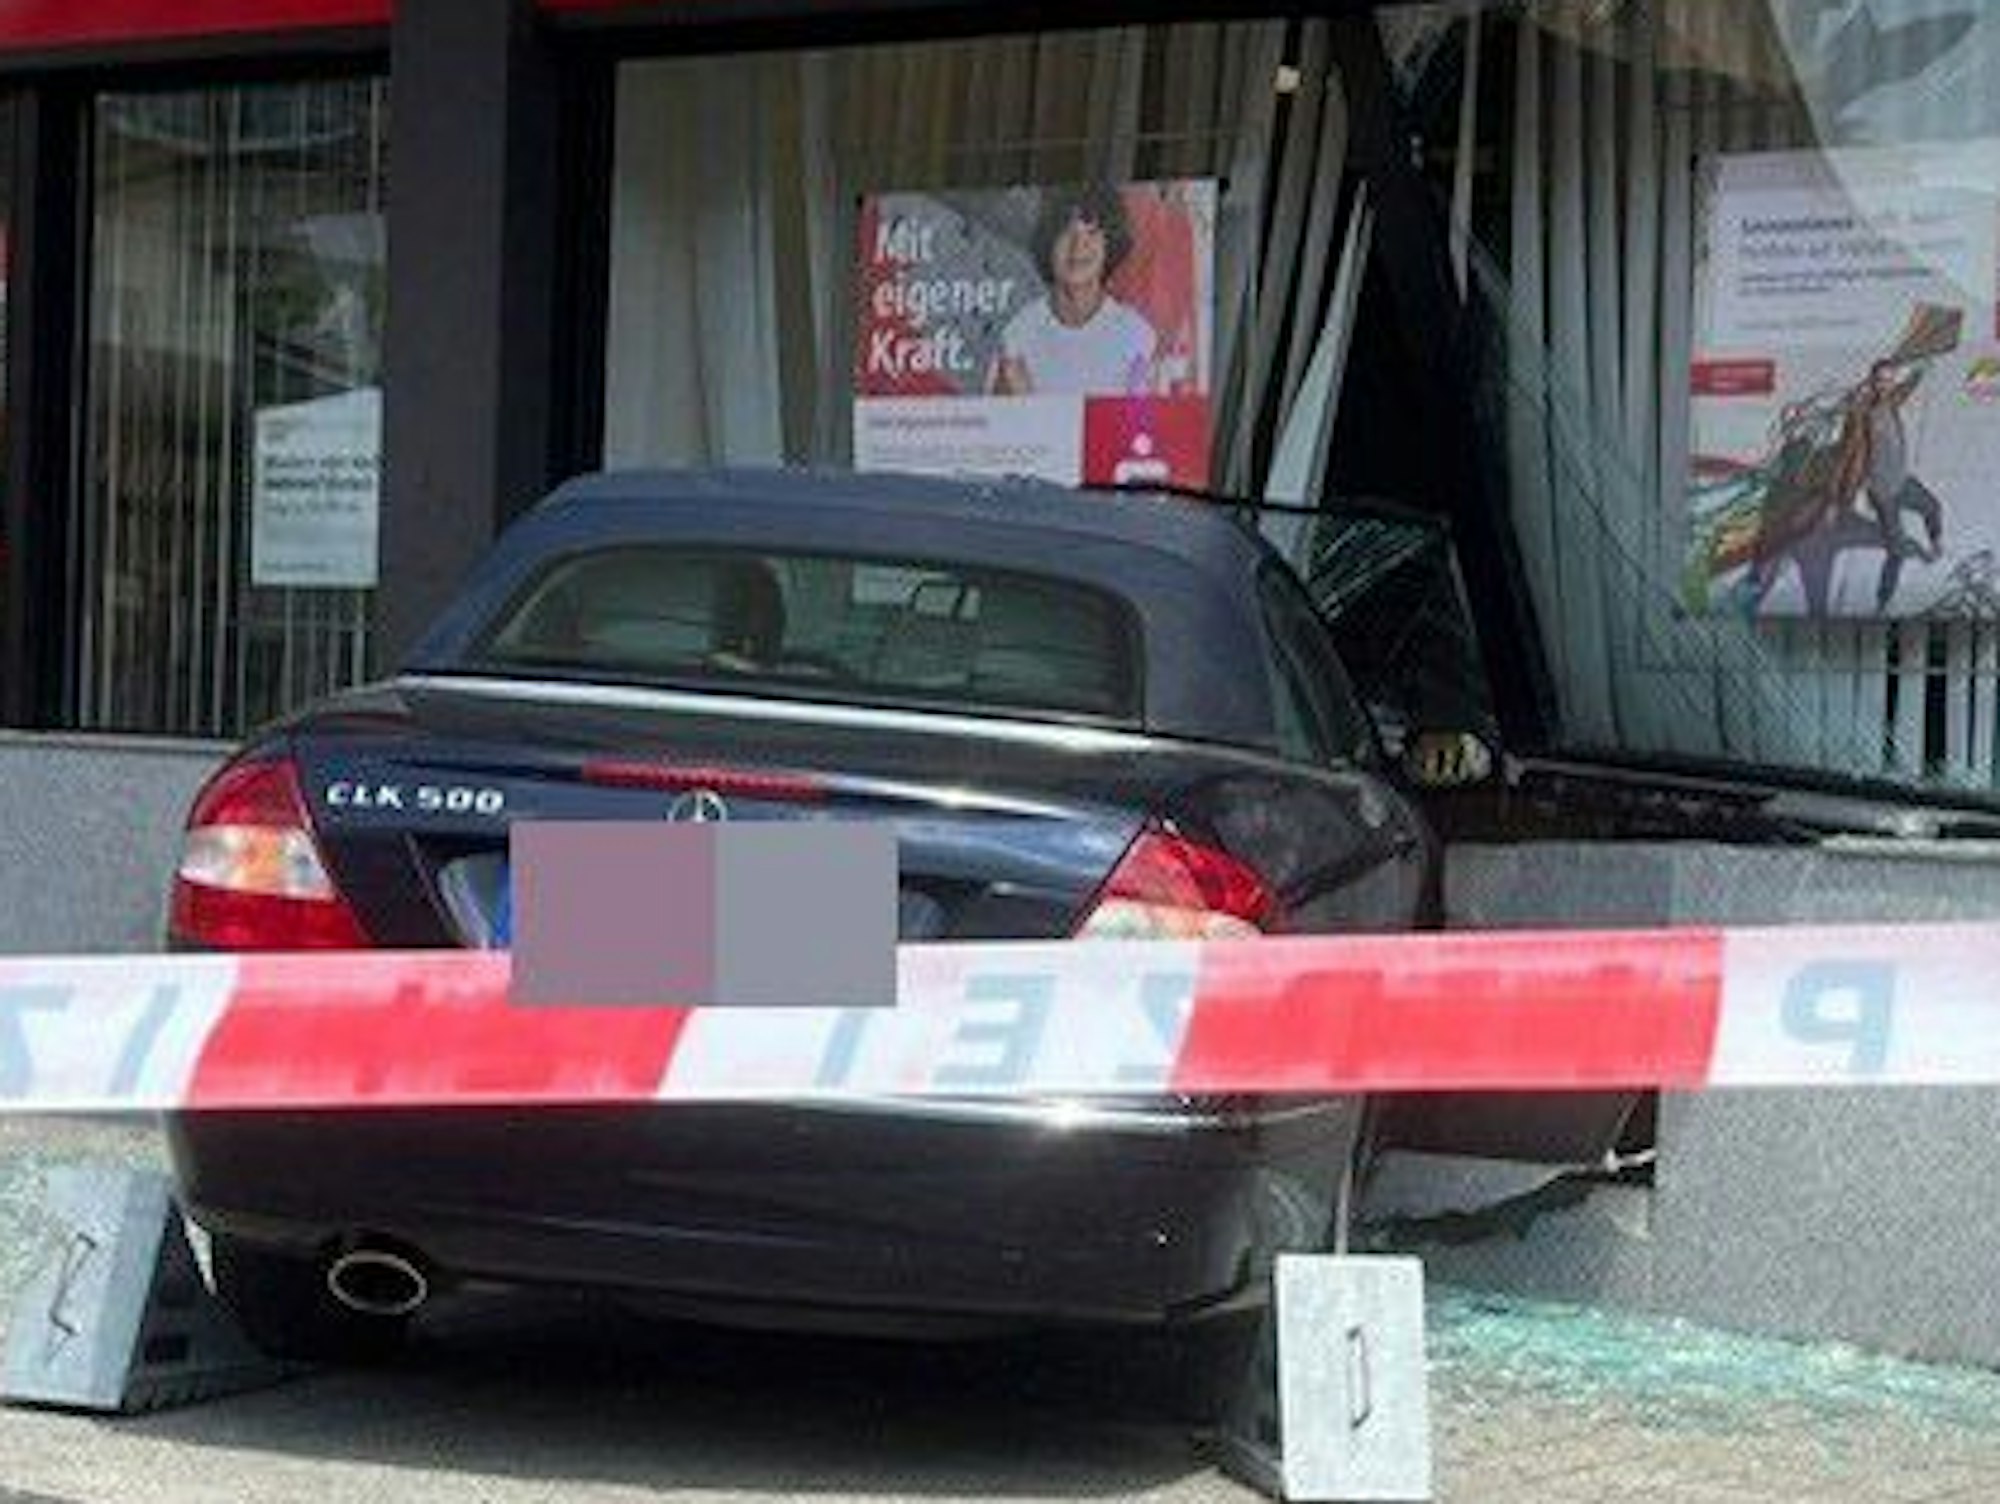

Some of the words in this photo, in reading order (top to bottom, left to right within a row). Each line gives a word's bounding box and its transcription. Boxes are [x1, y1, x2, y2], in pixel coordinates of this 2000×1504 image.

[874, 217, 933, 263] Mit
[873, 272, 1014, 328] eigener
[867, 325, 975, 378] Kraft.
[326, 781, 403, 809] CLK
[417, 785, 505, 815] 500
